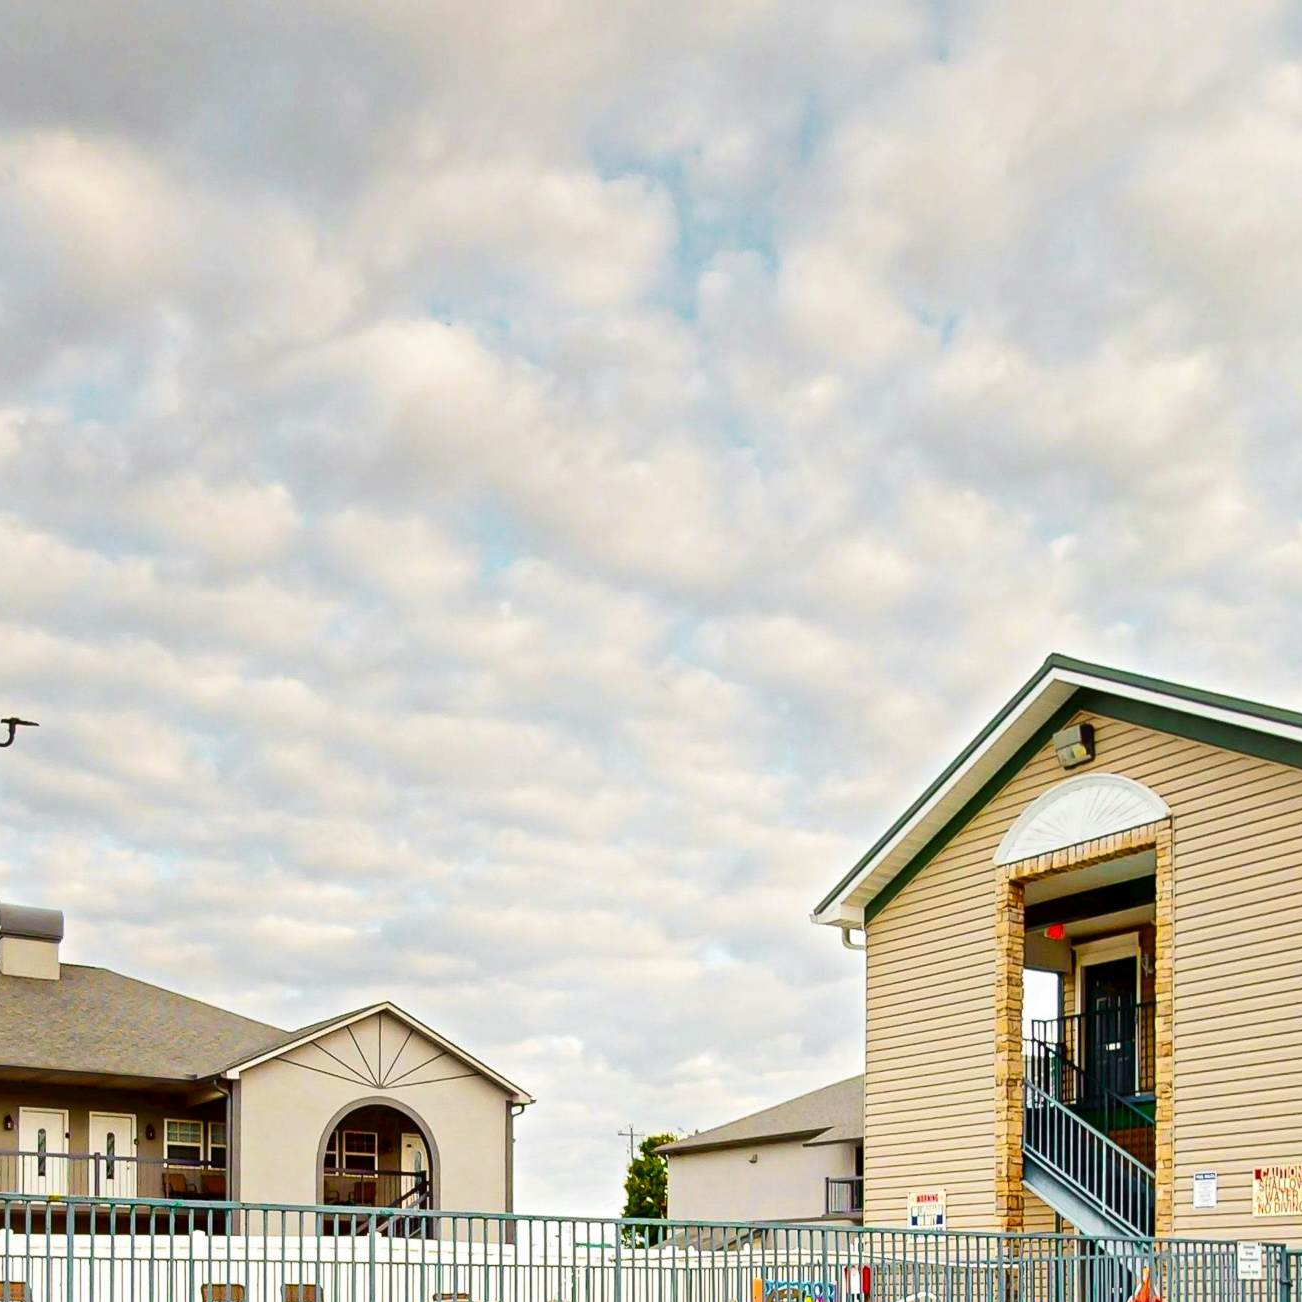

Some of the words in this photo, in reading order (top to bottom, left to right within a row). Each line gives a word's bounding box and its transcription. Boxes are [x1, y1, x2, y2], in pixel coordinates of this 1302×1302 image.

[1261, 1166, 1302, 1178] CAUTION
[916, 1194, 939, 1203] WARNING
[1265, 1188, 1298, 1202] WATER
[1258, 1202, 1271, 1214] NO
